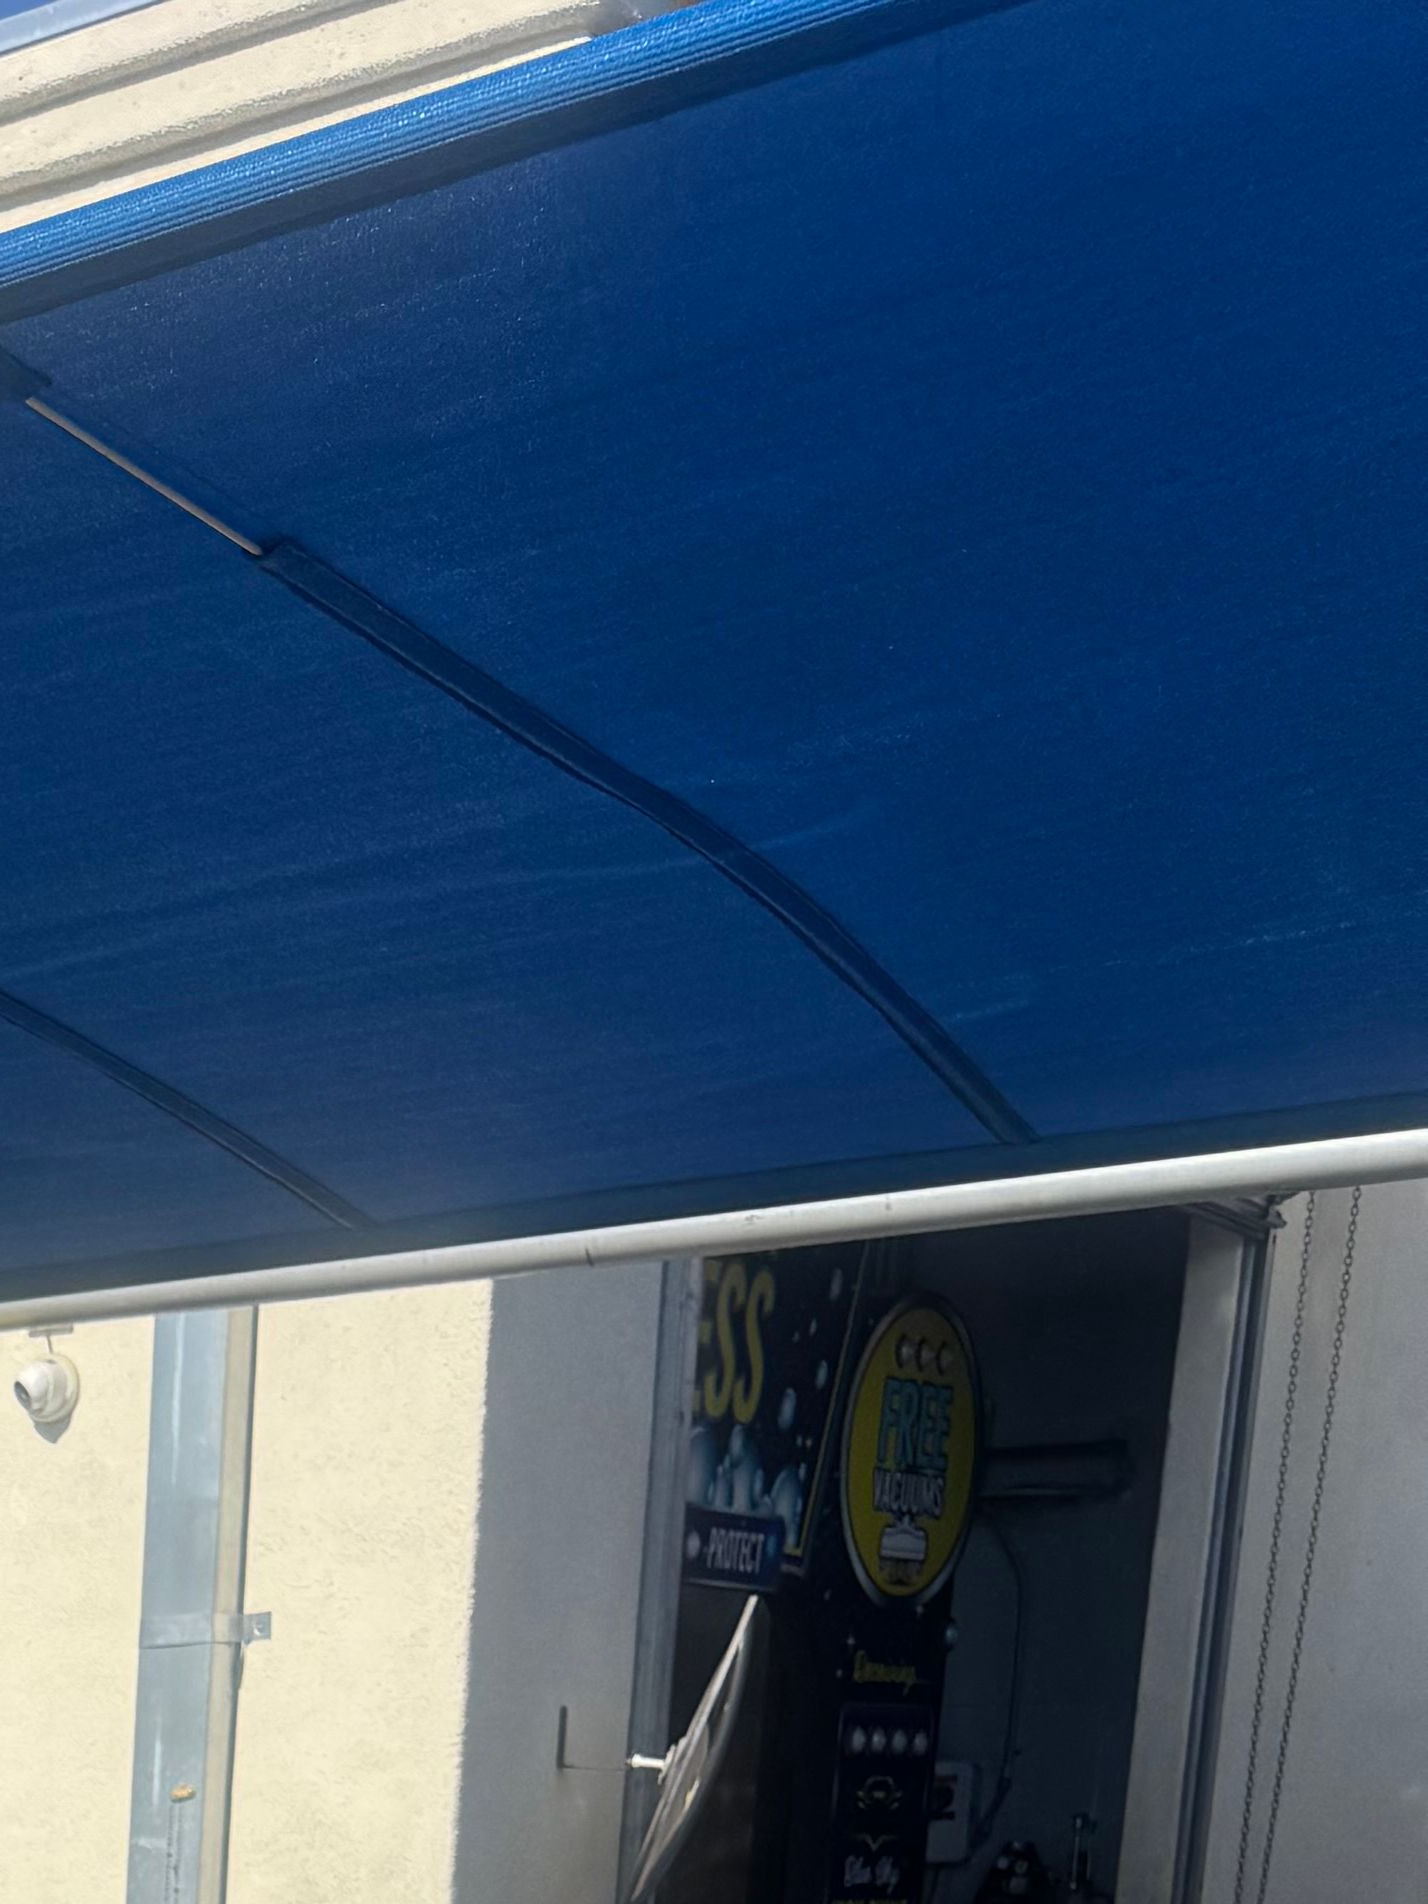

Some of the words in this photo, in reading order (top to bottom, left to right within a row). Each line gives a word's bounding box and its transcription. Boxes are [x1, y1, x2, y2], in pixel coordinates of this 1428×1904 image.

[877, 1376, 954, 1473] FREE
[872, 1469, 945, 1519] VACUUMS
[706, 1526, 766, 1575] PROTECT
